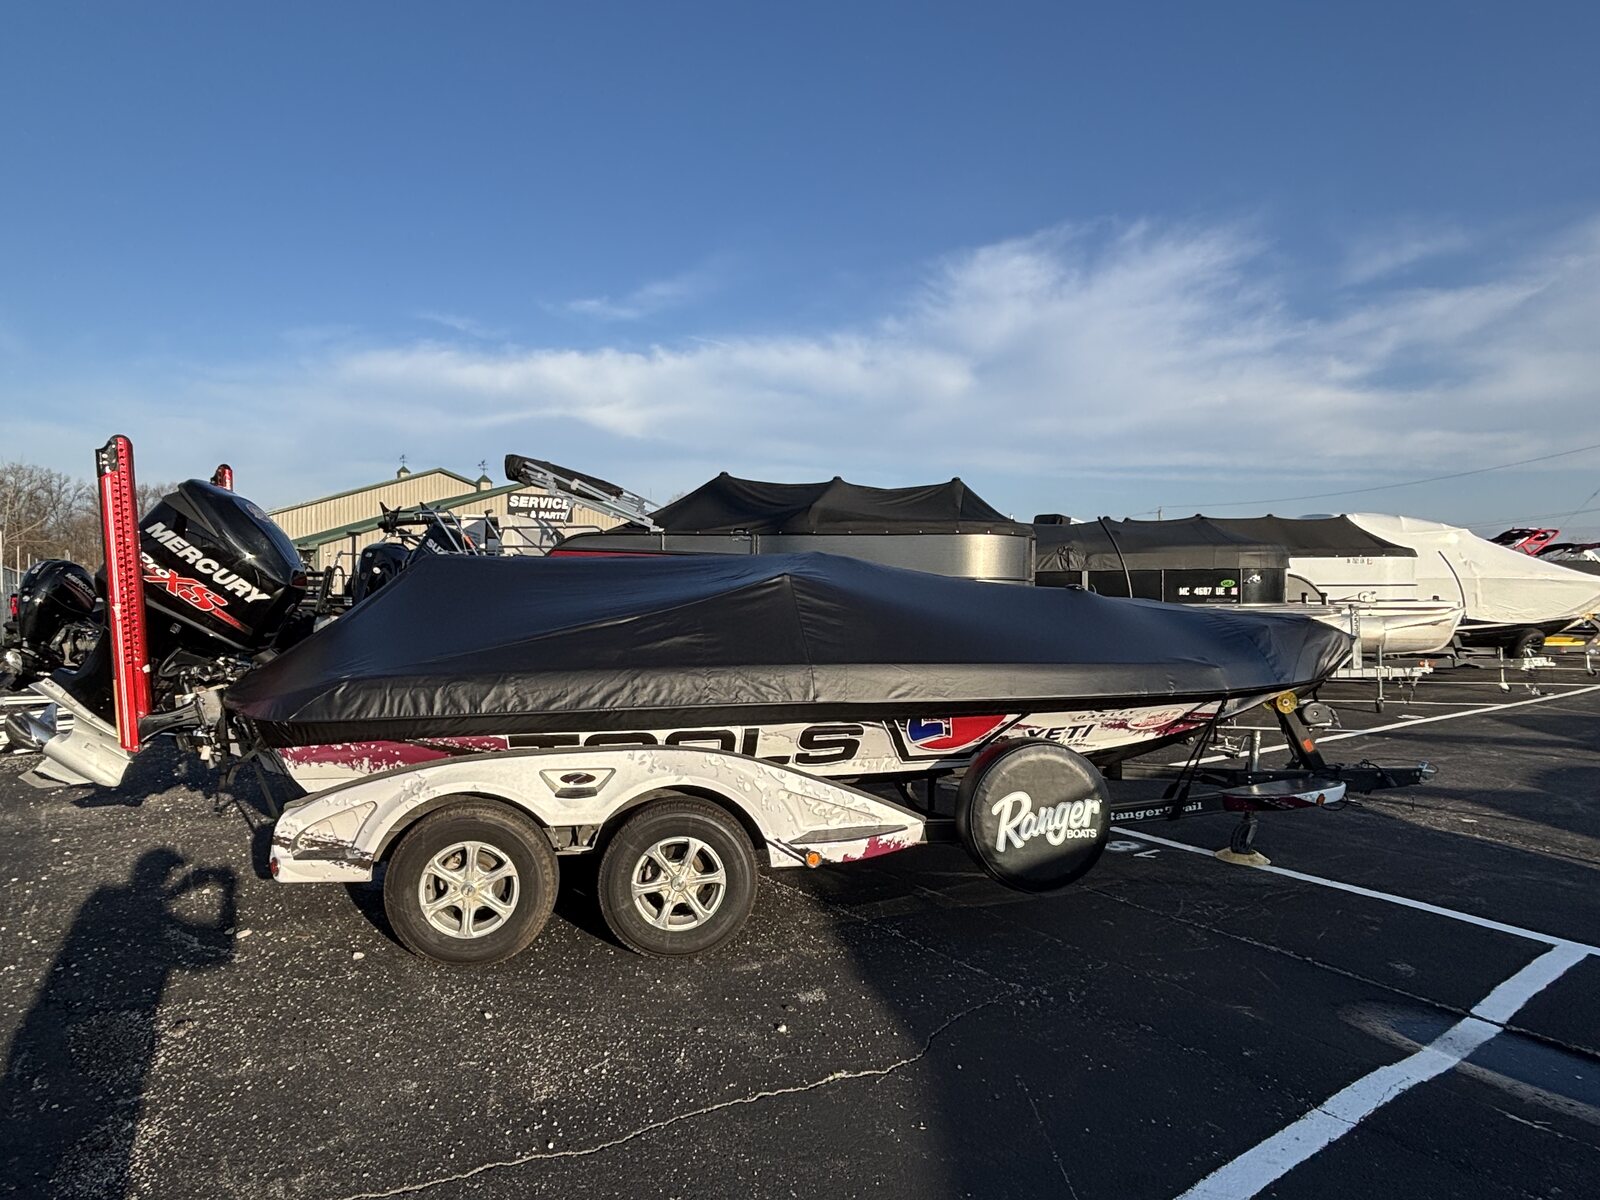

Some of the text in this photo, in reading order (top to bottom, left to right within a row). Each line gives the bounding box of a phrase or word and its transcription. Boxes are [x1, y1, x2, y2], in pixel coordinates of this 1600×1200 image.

[509, 495, 569, 511] SERVICE
[538, 510, 566, 520] PARTS
[141, 551, 171, 578] Pro
[145, 521, 271, 603] MERCURY
[1027, 723, 1097, 741] YETI
[991, 790, 1101, 852] Ranger
[1066, 828, 1098, 839] BOATS
